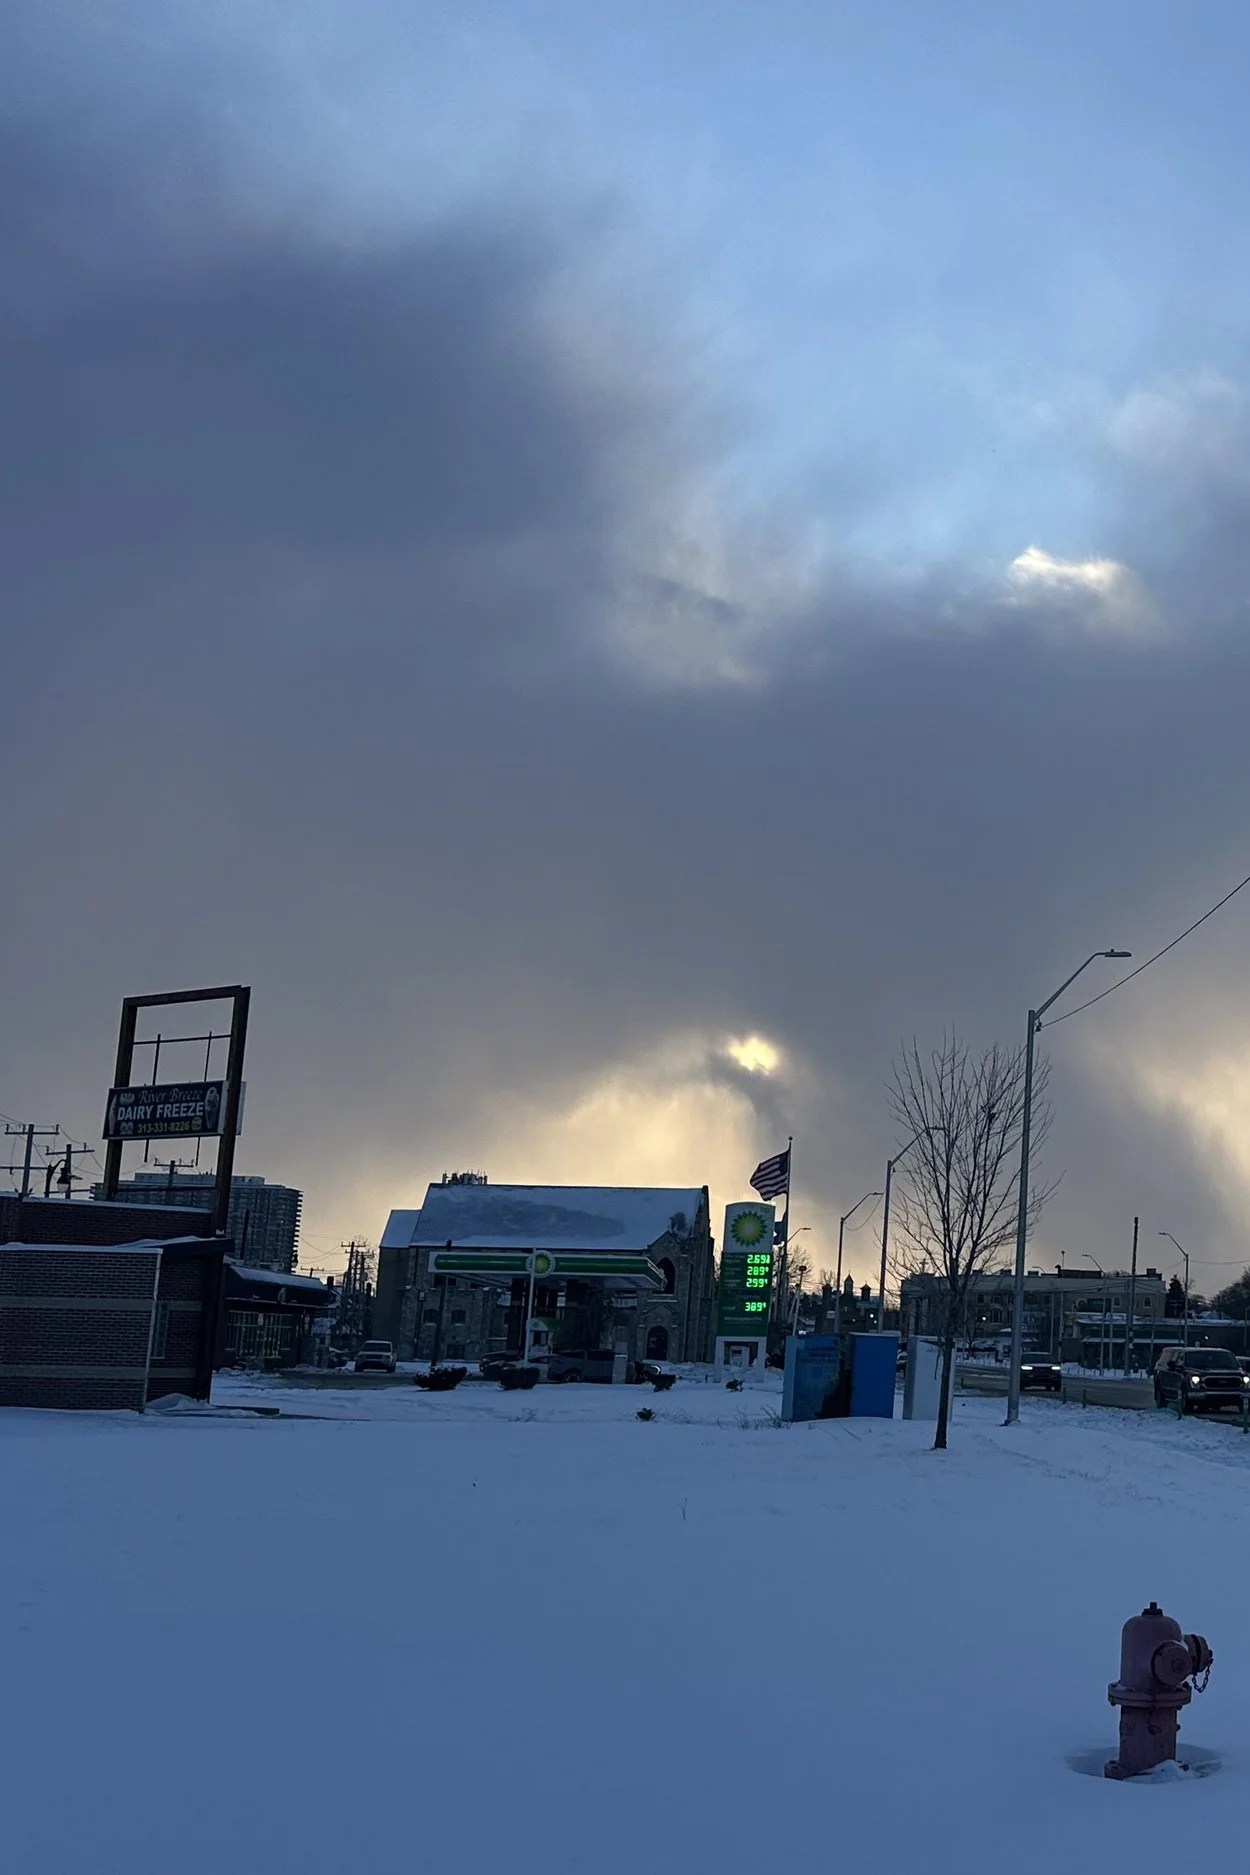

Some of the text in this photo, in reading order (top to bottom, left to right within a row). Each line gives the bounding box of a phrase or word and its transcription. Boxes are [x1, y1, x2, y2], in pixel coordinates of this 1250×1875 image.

[140, 1087, 203, 1104] River Breeze
[117, 1101, 204, 1121] DAIRY FREEZE
